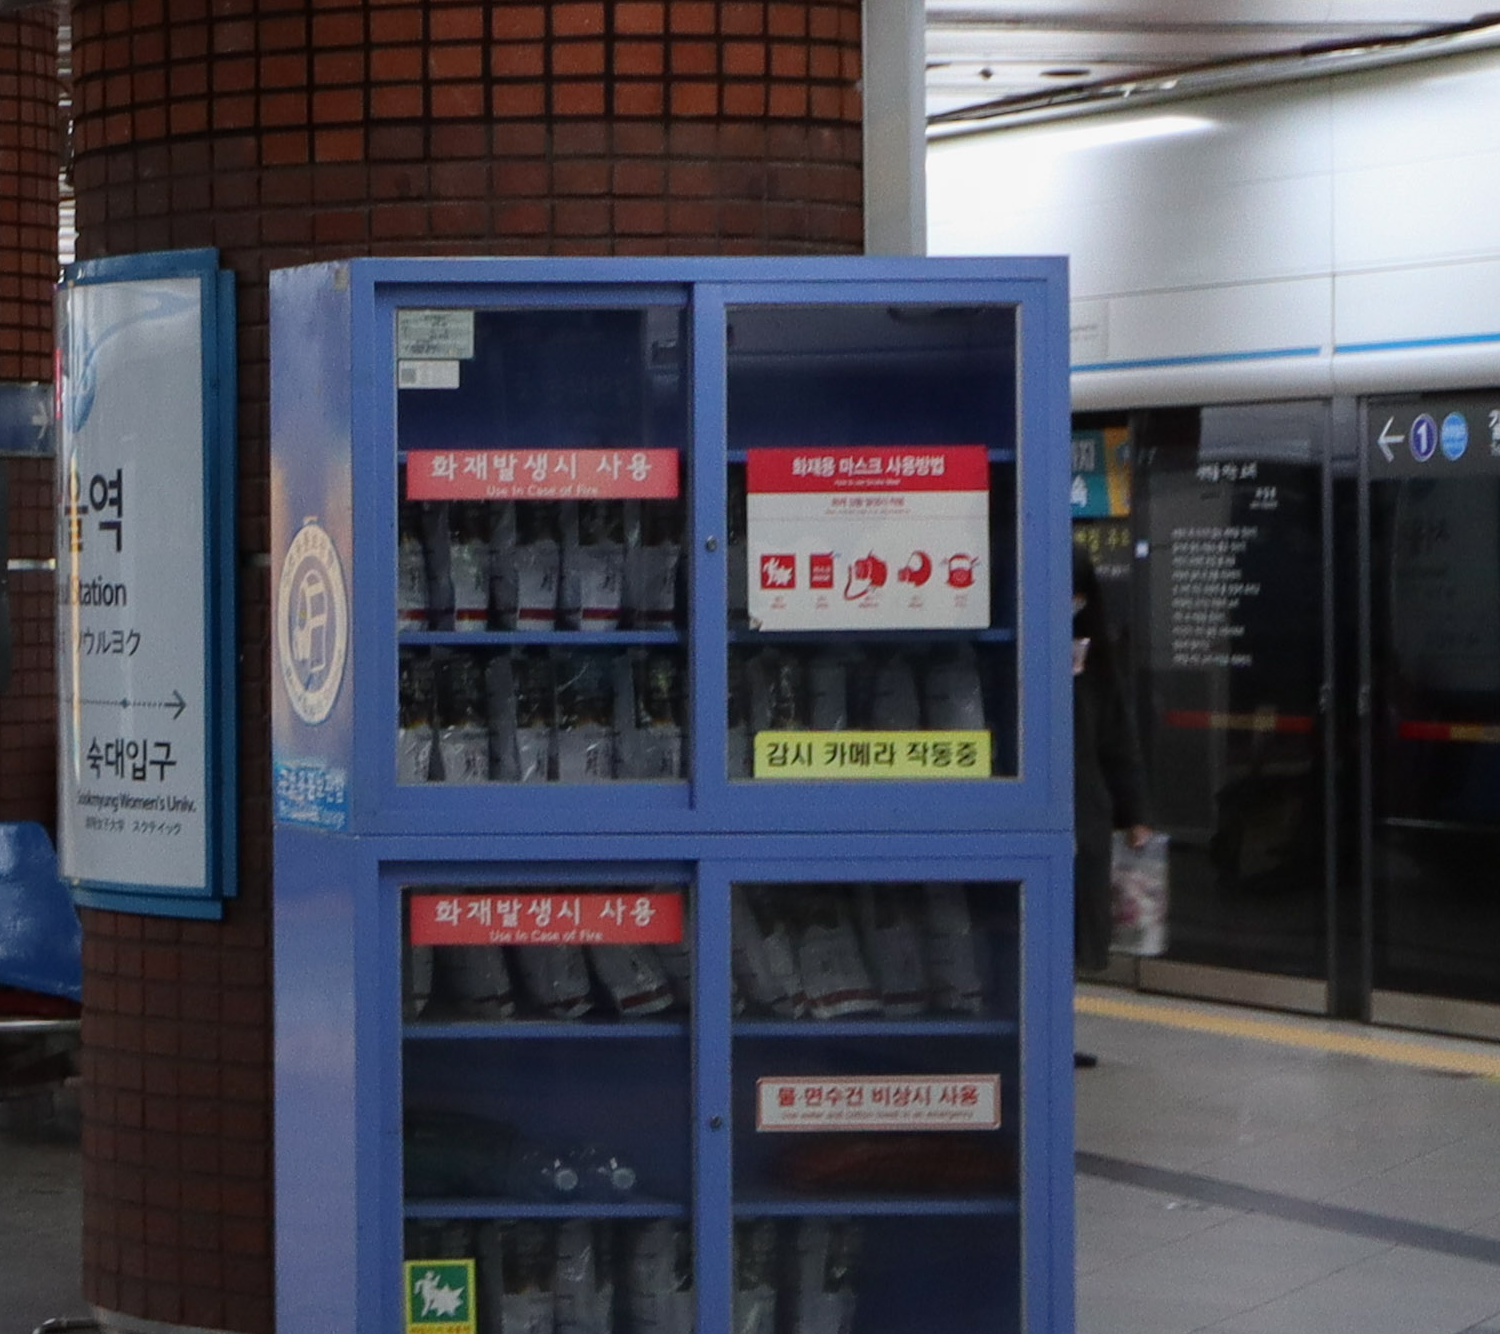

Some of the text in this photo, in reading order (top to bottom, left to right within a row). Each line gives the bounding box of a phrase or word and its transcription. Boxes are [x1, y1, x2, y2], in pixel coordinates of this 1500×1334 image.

[1416, 422, 1428, 455] 1
[431, 451, 652, 482] 화재발생시 사용
[791, 455, 947, 478] 화재용 마스크 사용방법
[86, 736, 177, 782] 숙대입구
[767, 741, 978, 767] 감시 카메라 작동중
[167, 795, 197, 815] Univ.
[435, 897, 656, 928] 화재발생시 사용
[872, 1085, 932, 1107] 비상시
[939, 1085, 980, 1107] 사용
